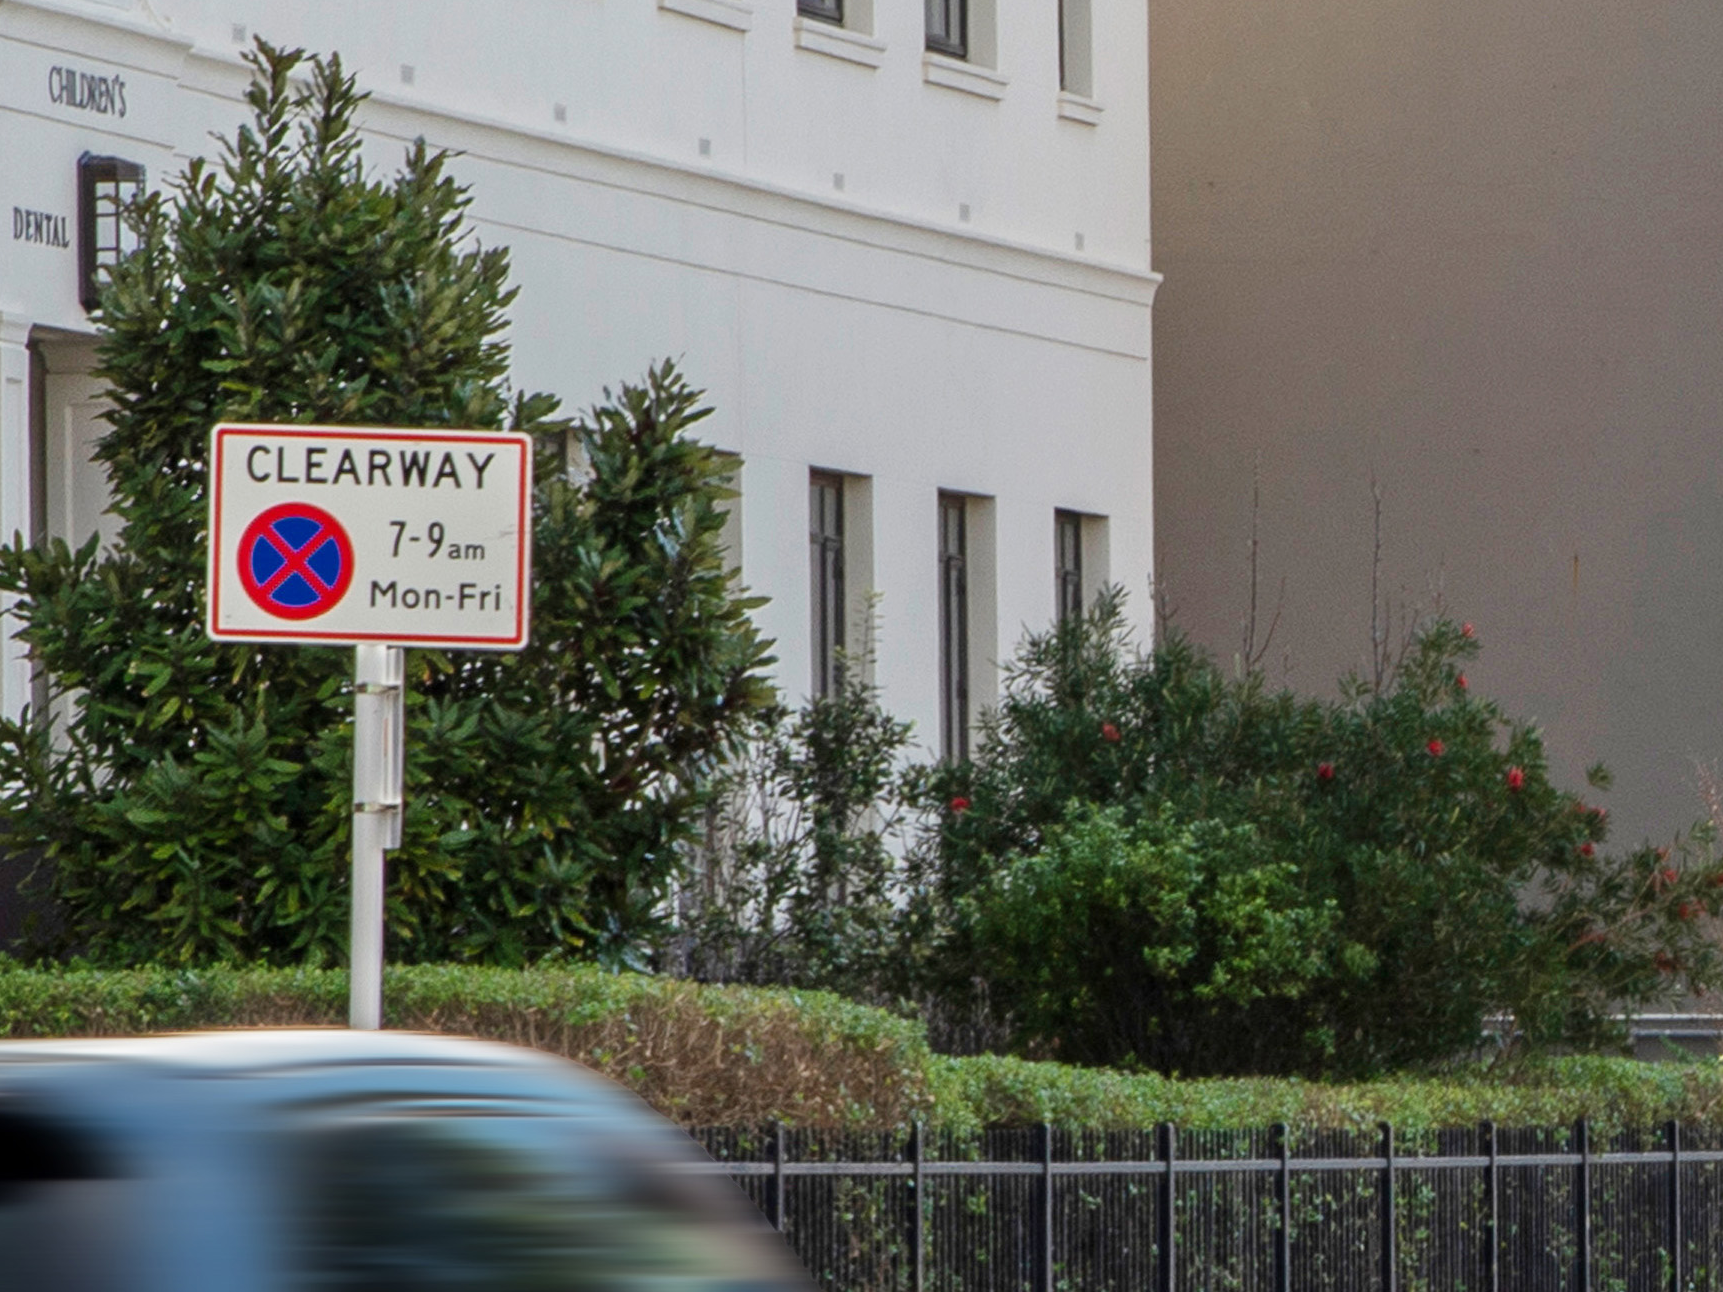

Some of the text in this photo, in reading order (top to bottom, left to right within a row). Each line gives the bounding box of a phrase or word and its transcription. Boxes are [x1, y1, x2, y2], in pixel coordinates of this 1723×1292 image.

[48, 65, 127, 119] CHILDREN'S
[13, 207, 70, 249] DENTAL
[246, 444, 496, 489] CLEARWAY
[369, 580, 502, 610] Mon-Fri
